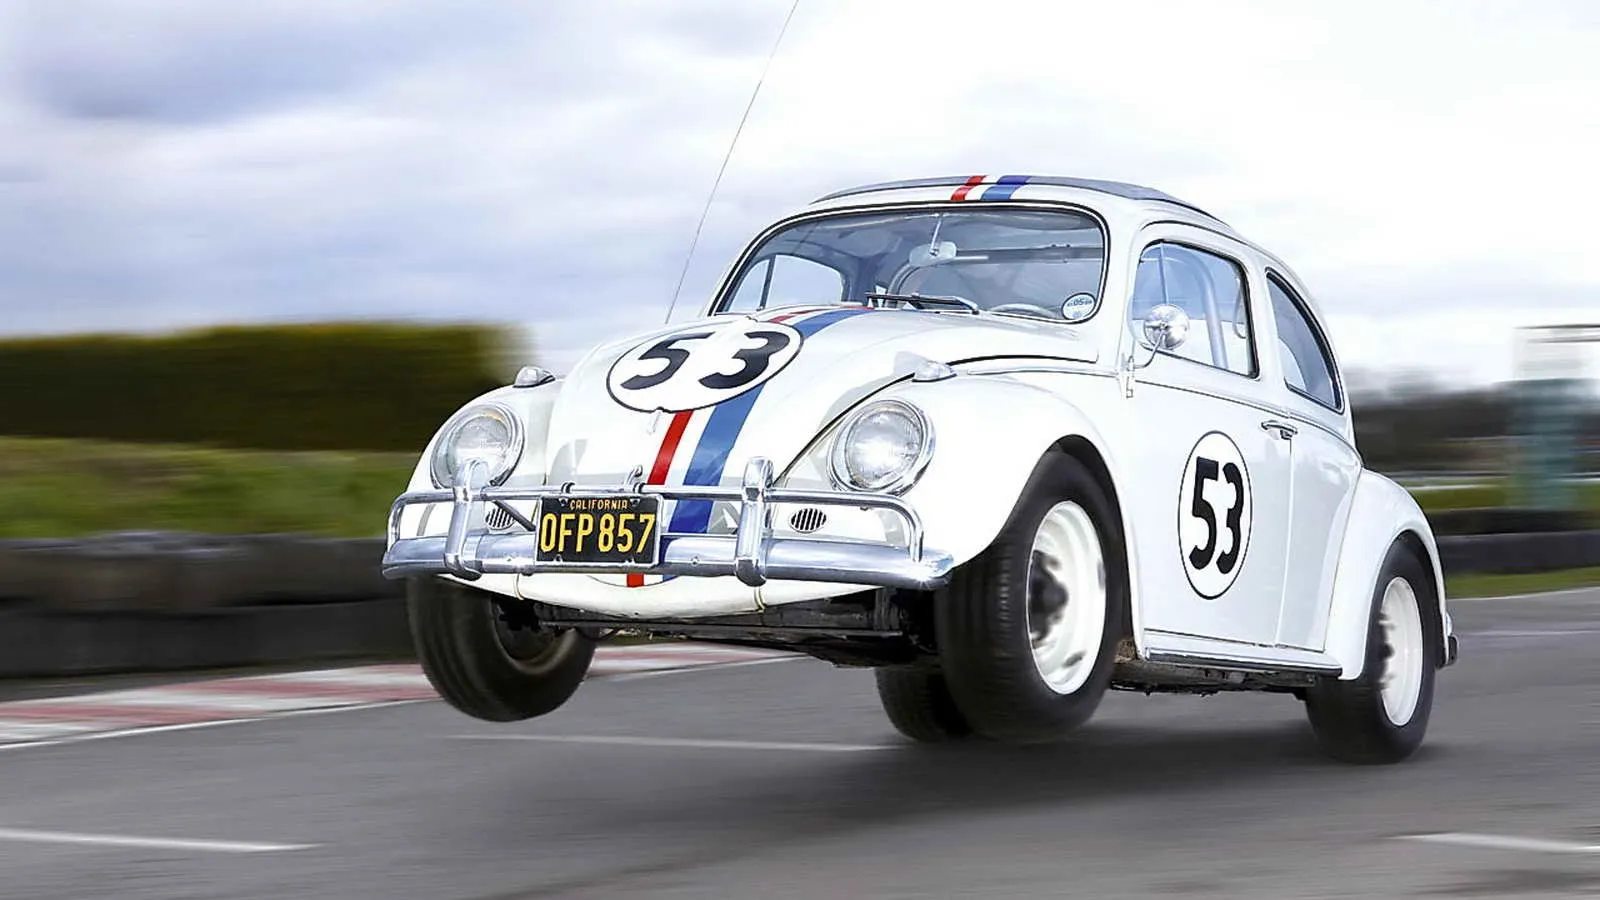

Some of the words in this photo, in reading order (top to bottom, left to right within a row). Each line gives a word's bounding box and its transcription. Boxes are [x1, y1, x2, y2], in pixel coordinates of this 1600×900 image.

[620, 331, 790, 390] 53
[569, 499, 628, 510] CALIFORNIA
[1189, 456, 1244, 574] 53
[598, 513, 656, 553] 857
